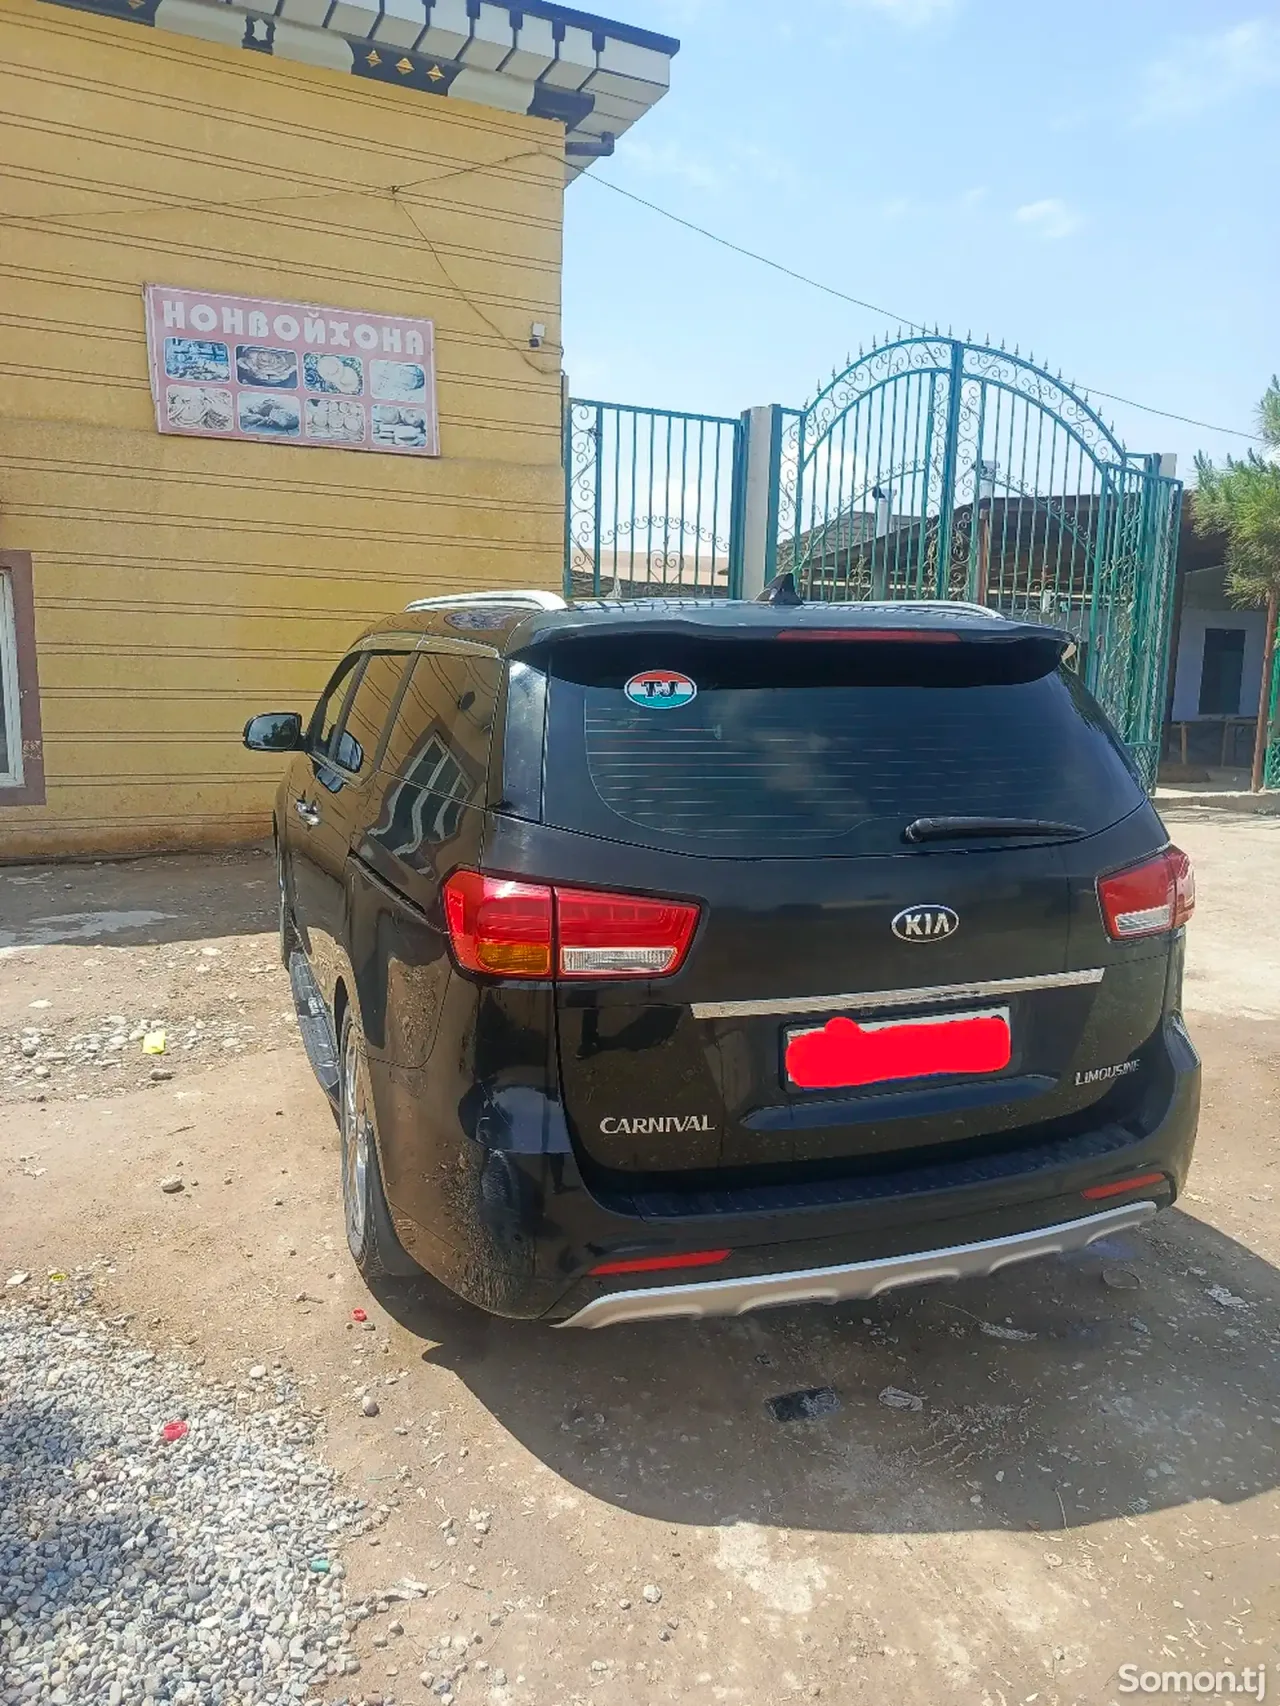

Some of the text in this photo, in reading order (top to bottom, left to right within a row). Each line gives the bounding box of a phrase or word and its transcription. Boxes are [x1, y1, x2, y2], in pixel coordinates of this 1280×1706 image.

[162, 300, 425, 355] НОНВОЙХОНА
[641, 680, 678, 698] TJ
[904, 912, 950, 935] KIA
[1075, 1059, 1141, 1086] LIMOUSINE
[599, 1114, 717, 1134] CARNIVAL
